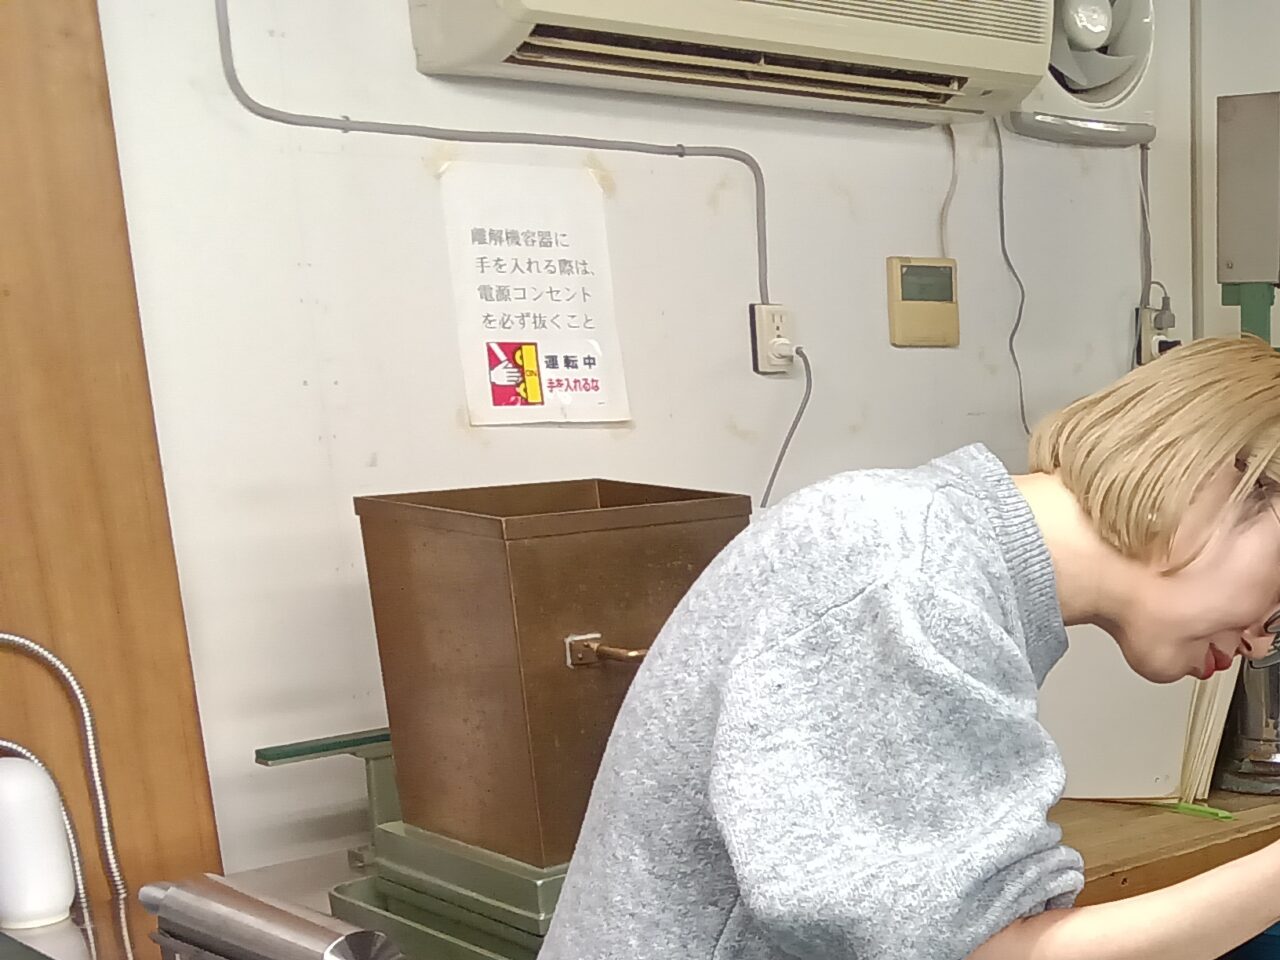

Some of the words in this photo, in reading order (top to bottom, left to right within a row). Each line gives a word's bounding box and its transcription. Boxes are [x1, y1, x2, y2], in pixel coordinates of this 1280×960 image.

[475, 256, 596, 276] 手を入れる際は、
[477, 285, 592, 303] 電源コンセント
[482, 312, 596, 330] を必ず抜くこと
[544, 354, 597, 370] 運転中
[547, 378, 600, 393] 手を入れるな
